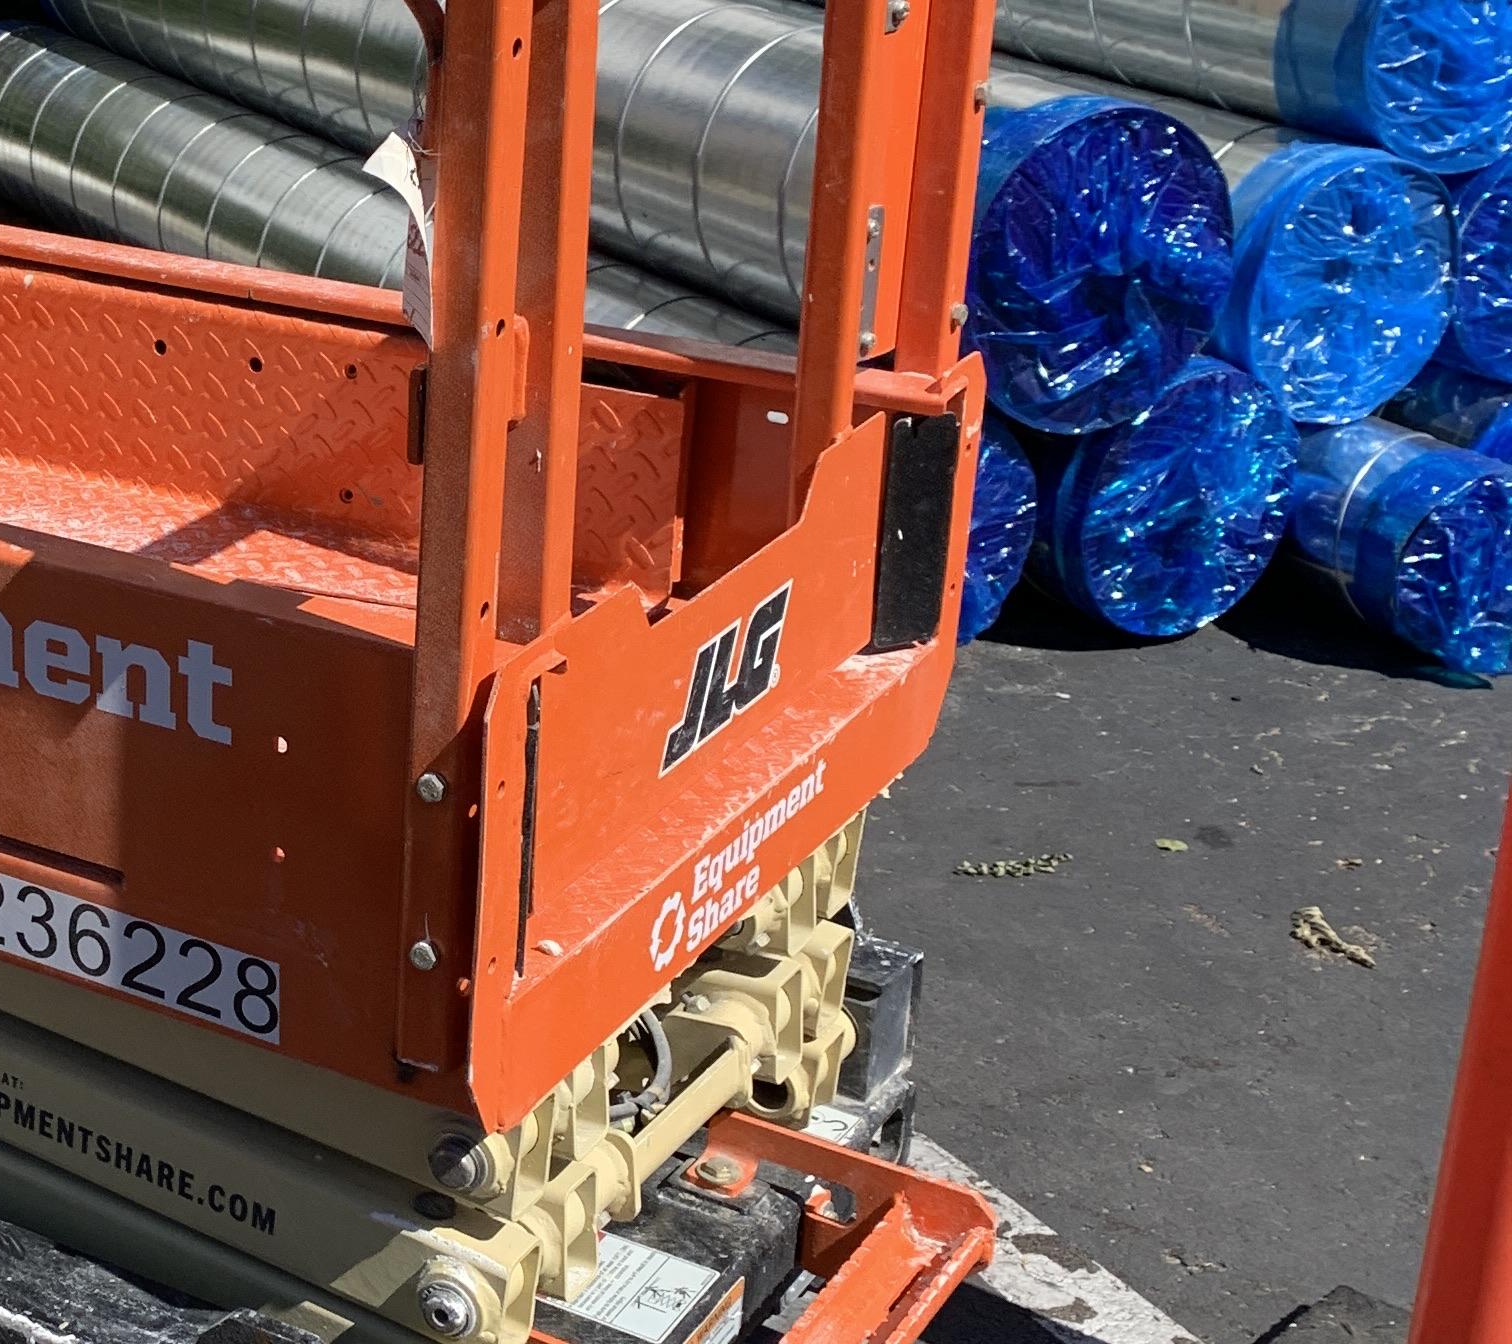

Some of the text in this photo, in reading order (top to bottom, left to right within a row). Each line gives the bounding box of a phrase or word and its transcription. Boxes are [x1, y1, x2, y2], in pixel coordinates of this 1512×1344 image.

[659, 578, 793, 778] JLG
[691, 759, 828, 904] Equipment
[686, 863, 761, 953] Share
[1, 1072, 24, 1091] AT:
